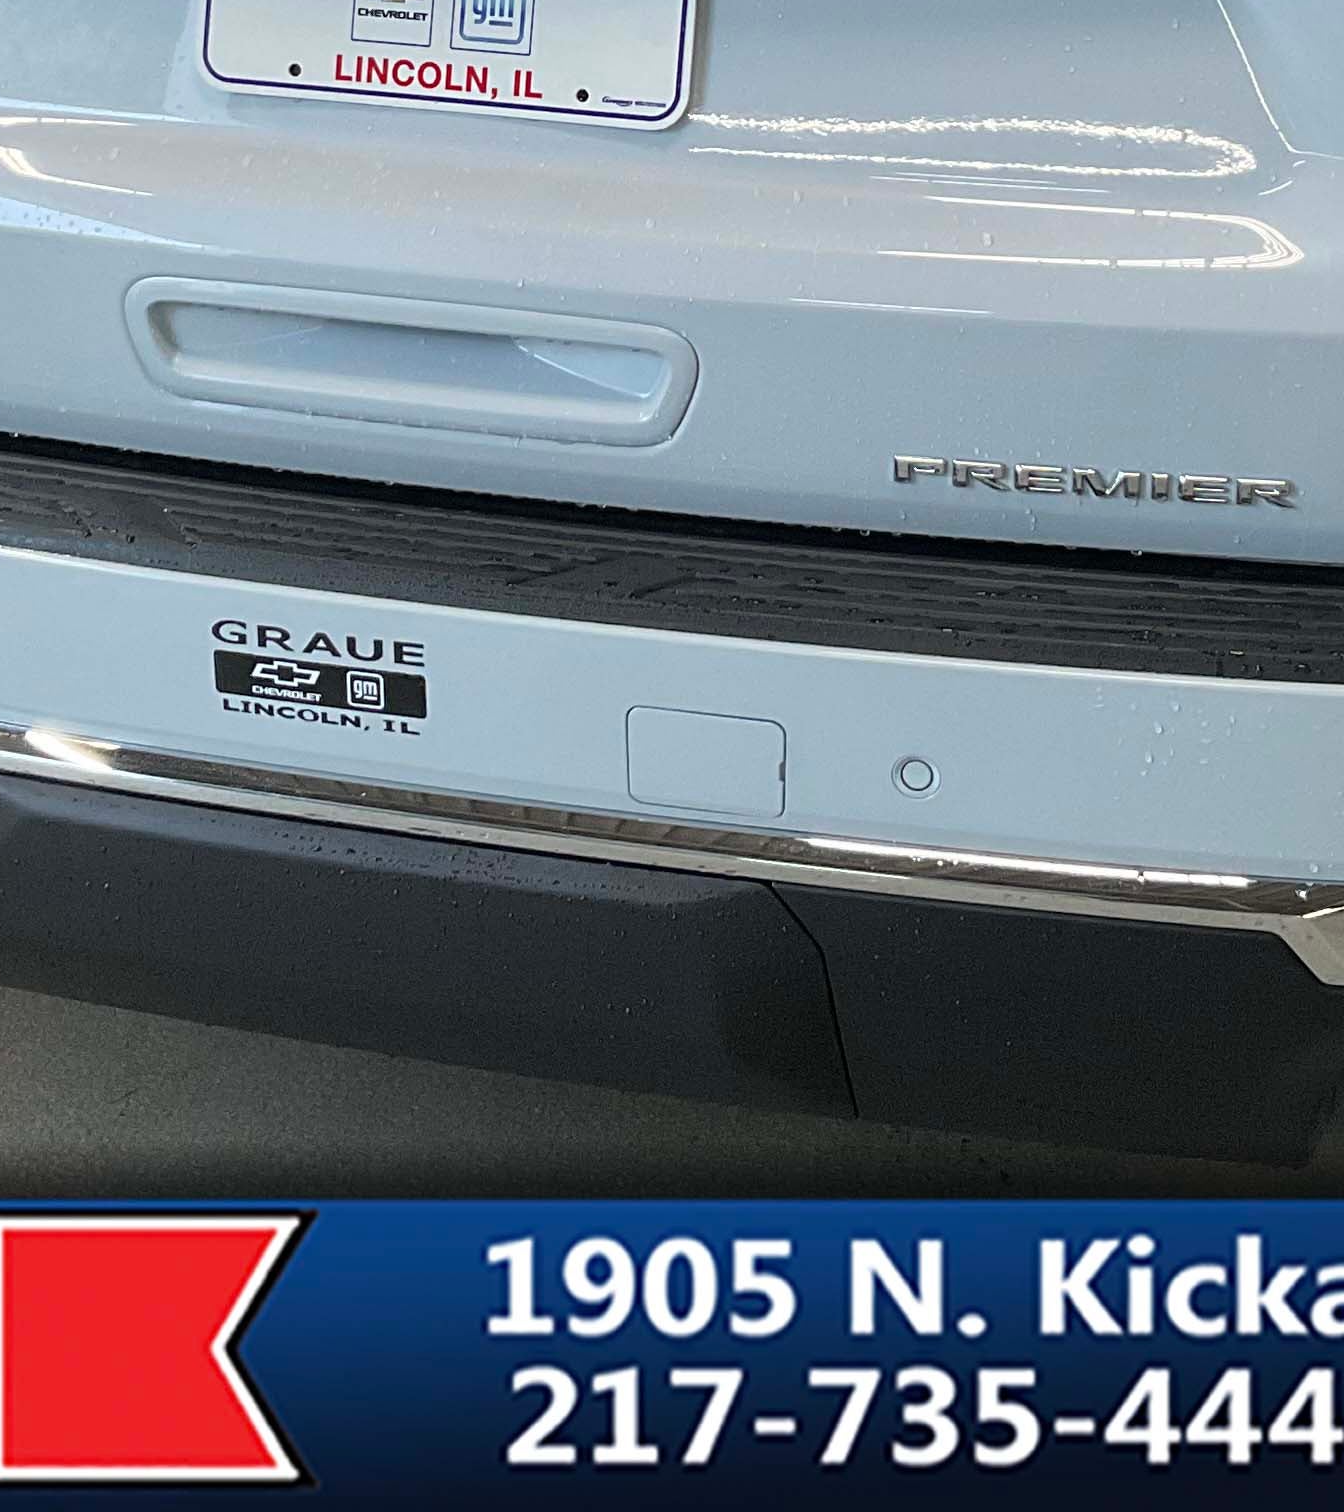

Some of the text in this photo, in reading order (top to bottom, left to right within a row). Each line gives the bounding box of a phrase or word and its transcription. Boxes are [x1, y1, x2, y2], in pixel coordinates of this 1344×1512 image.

[357, 7, 428, 21] CHEVROLET
[335, 54, 543, 99] LINCOLN, IL
[894, 454, 1296, 509] PREMIER
[211, 619, 425, 667] GRAUE
[251, 684, 323, 703] CHEVROLET
[222, 698, 421, 736] LINCOLN, IL
